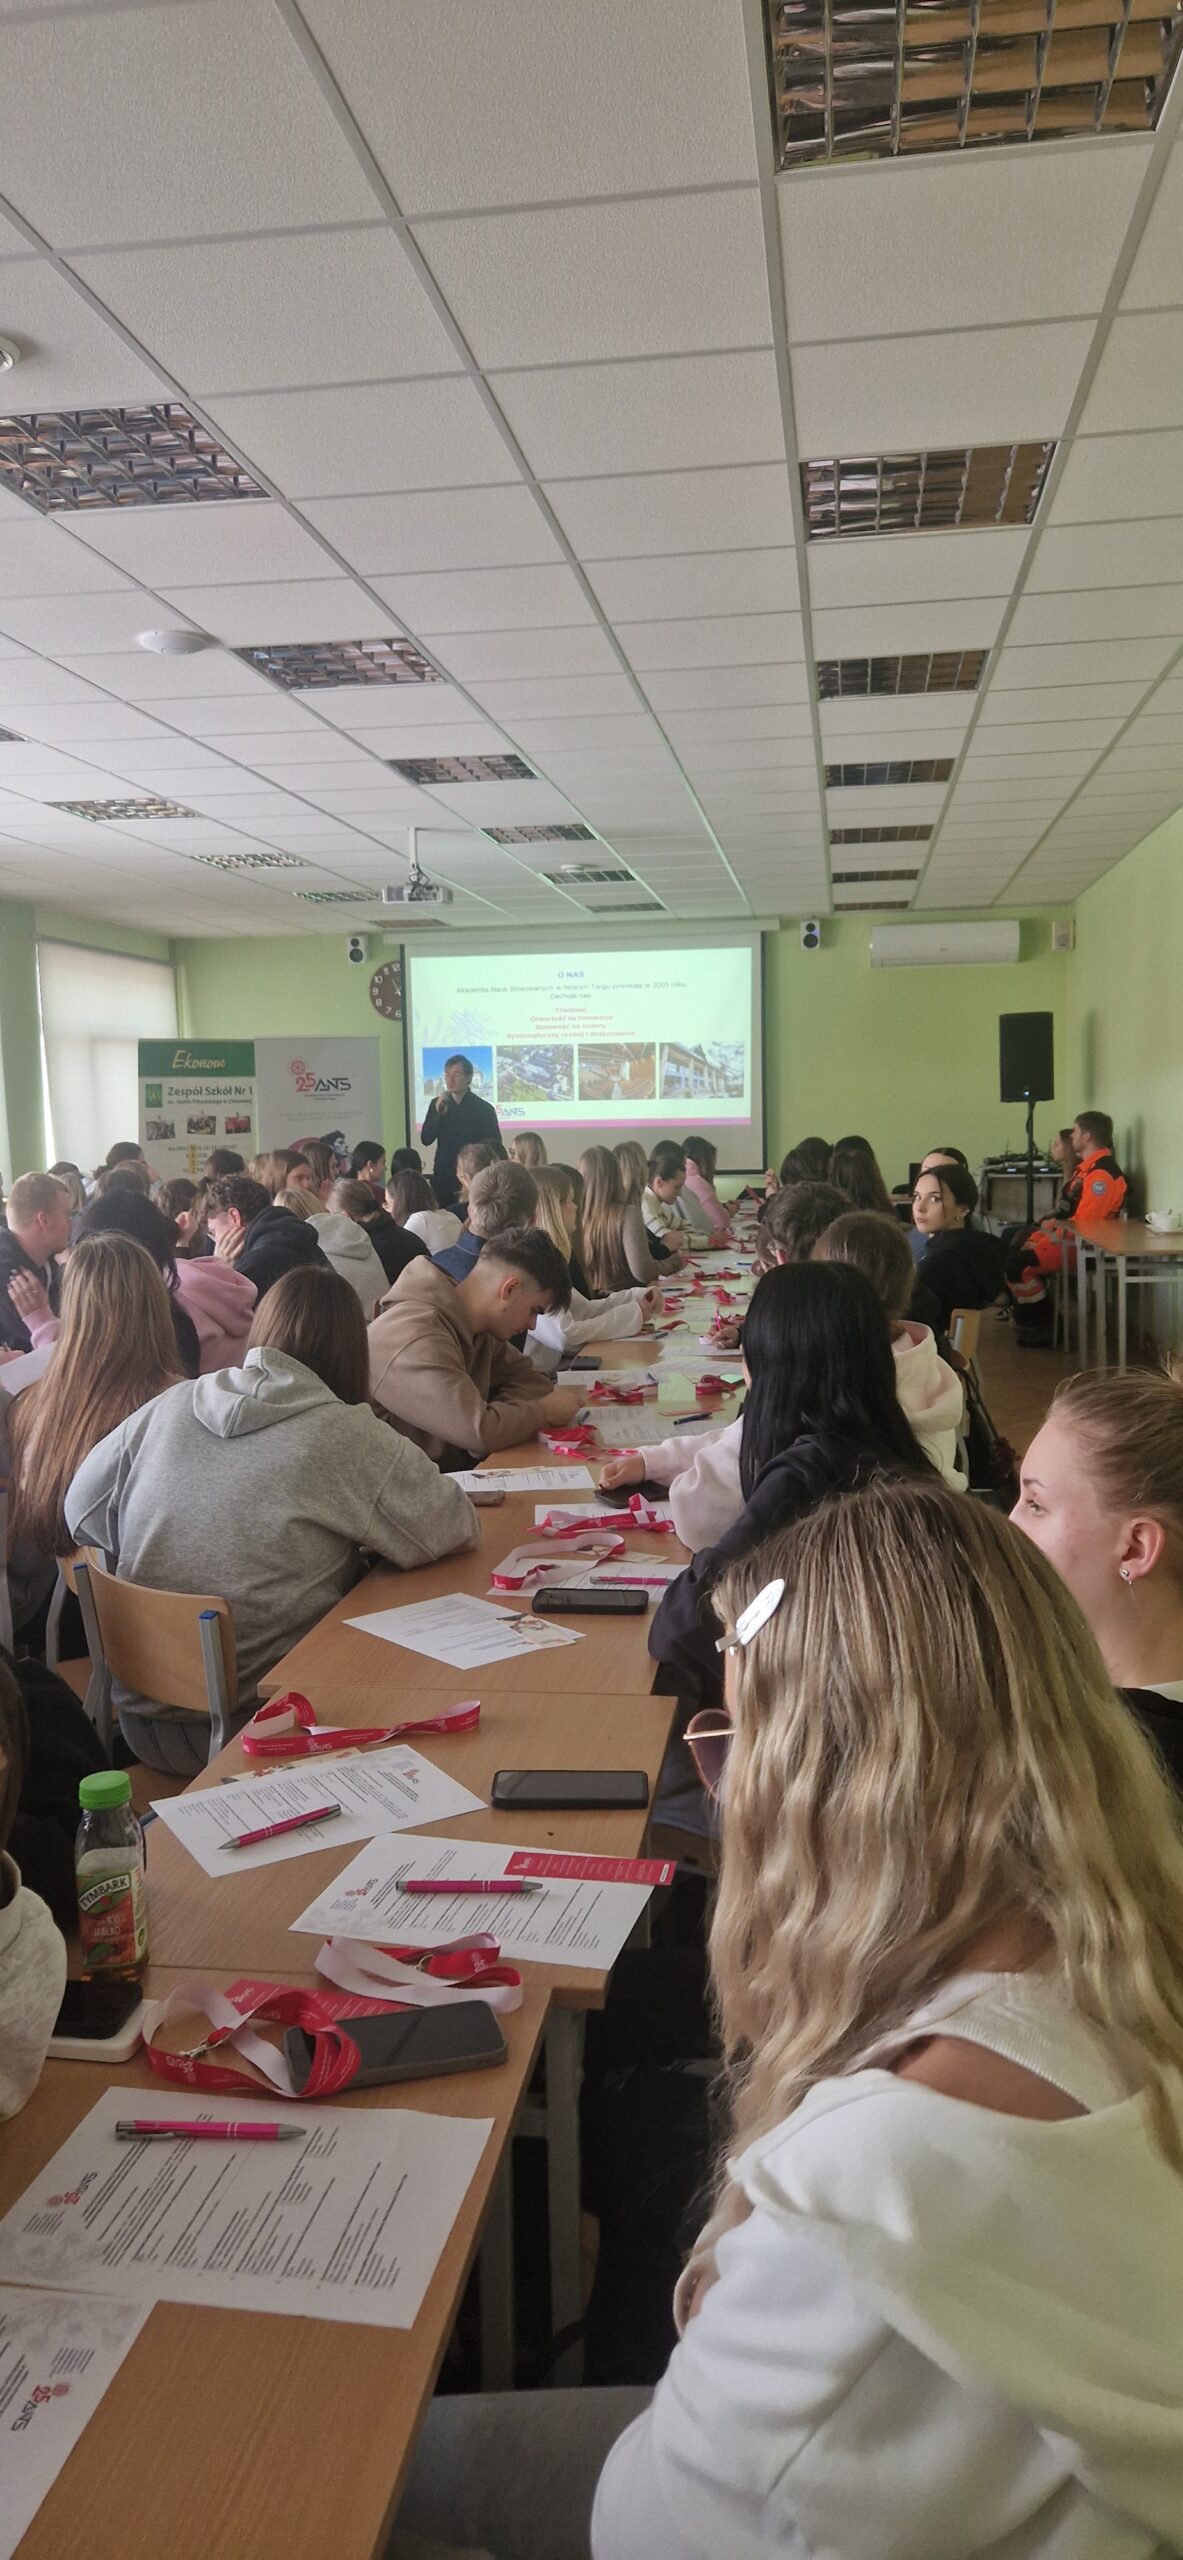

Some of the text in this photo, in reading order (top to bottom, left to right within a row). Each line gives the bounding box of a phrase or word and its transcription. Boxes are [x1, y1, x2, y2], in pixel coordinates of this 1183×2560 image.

[383, 967, 390, 975] 11
[374, 975, 383, 983] 10
[372, 987, 379, 995] 9
[375, 998, 382, 1006] 8
[385, 1006, 392, 1014] 7
[171, 1049, 226, 1069] Ekonom
[296, 1072, 316, 1092] 25
[168, 1086, 202, 1098] Zespół
[205, 1085, 232, 1096] Szkół
[235, 1086, 245, 1095] Nr
[79, 1876, 127, 1909] TYMBARK
[32, 2384, 52, 2404] 25
